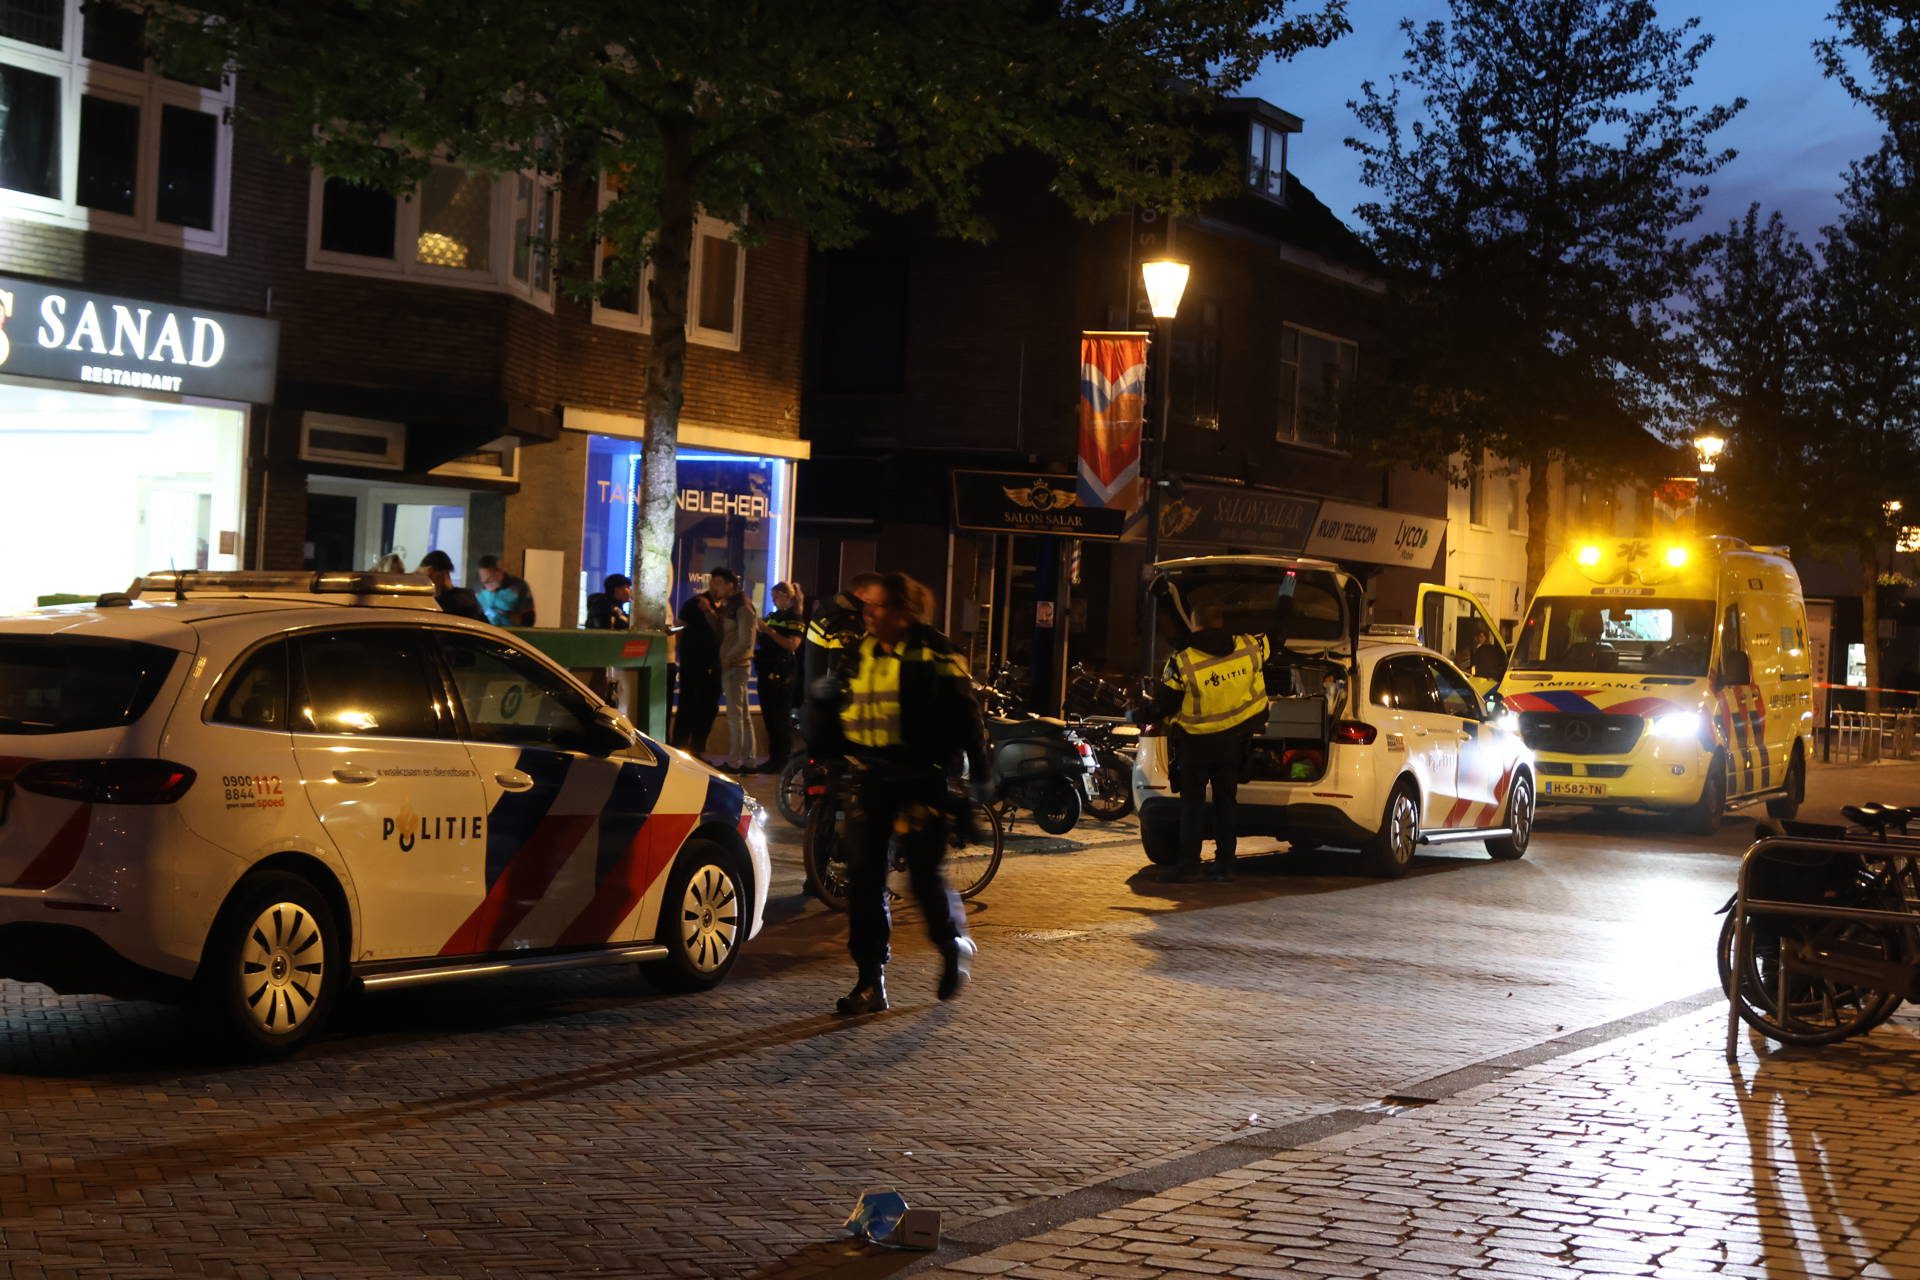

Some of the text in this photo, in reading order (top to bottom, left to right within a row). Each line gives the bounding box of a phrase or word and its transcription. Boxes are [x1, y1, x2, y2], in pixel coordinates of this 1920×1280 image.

[38, 294, 225, 368] SANAD
[81, 365, 182, 391] RESTAURANT
[1533, 680, 1651, 692] AMBULANCE
[223, 775, 252, 787] 0900
[253, 775, 283, 795] 112
[225, 788, 254, 800] 8844
[1553, 782, 1602, 795] H-582-TN
[256, 796, 285, 809] spoed
[382, 815, 482, 852] POLITIE
